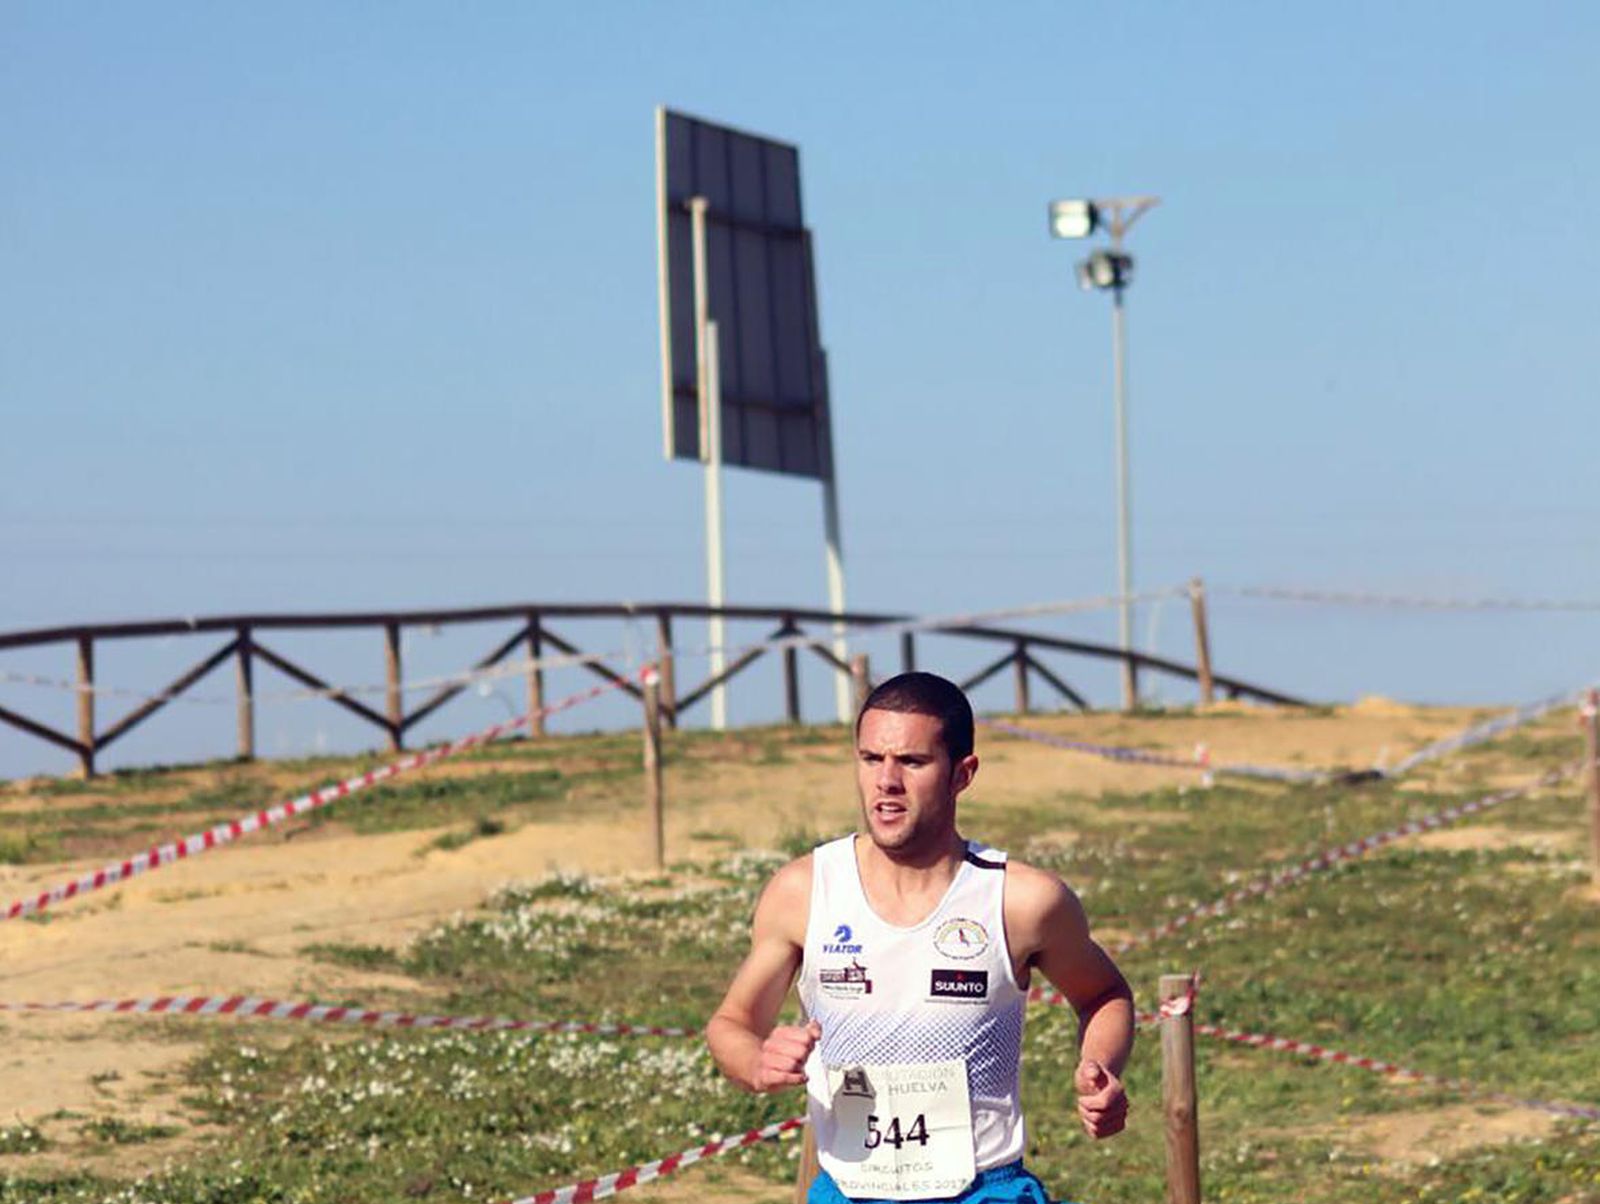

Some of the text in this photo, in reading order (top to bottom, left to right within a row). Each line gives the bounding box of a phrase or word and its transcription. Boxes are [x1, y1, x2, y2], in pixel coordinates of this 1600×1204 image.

[934, 980, 985, 993] SUUNTO
[888, 1081, 949, 1096] HUELVA
[864, 1113, 930, 1150] 544
